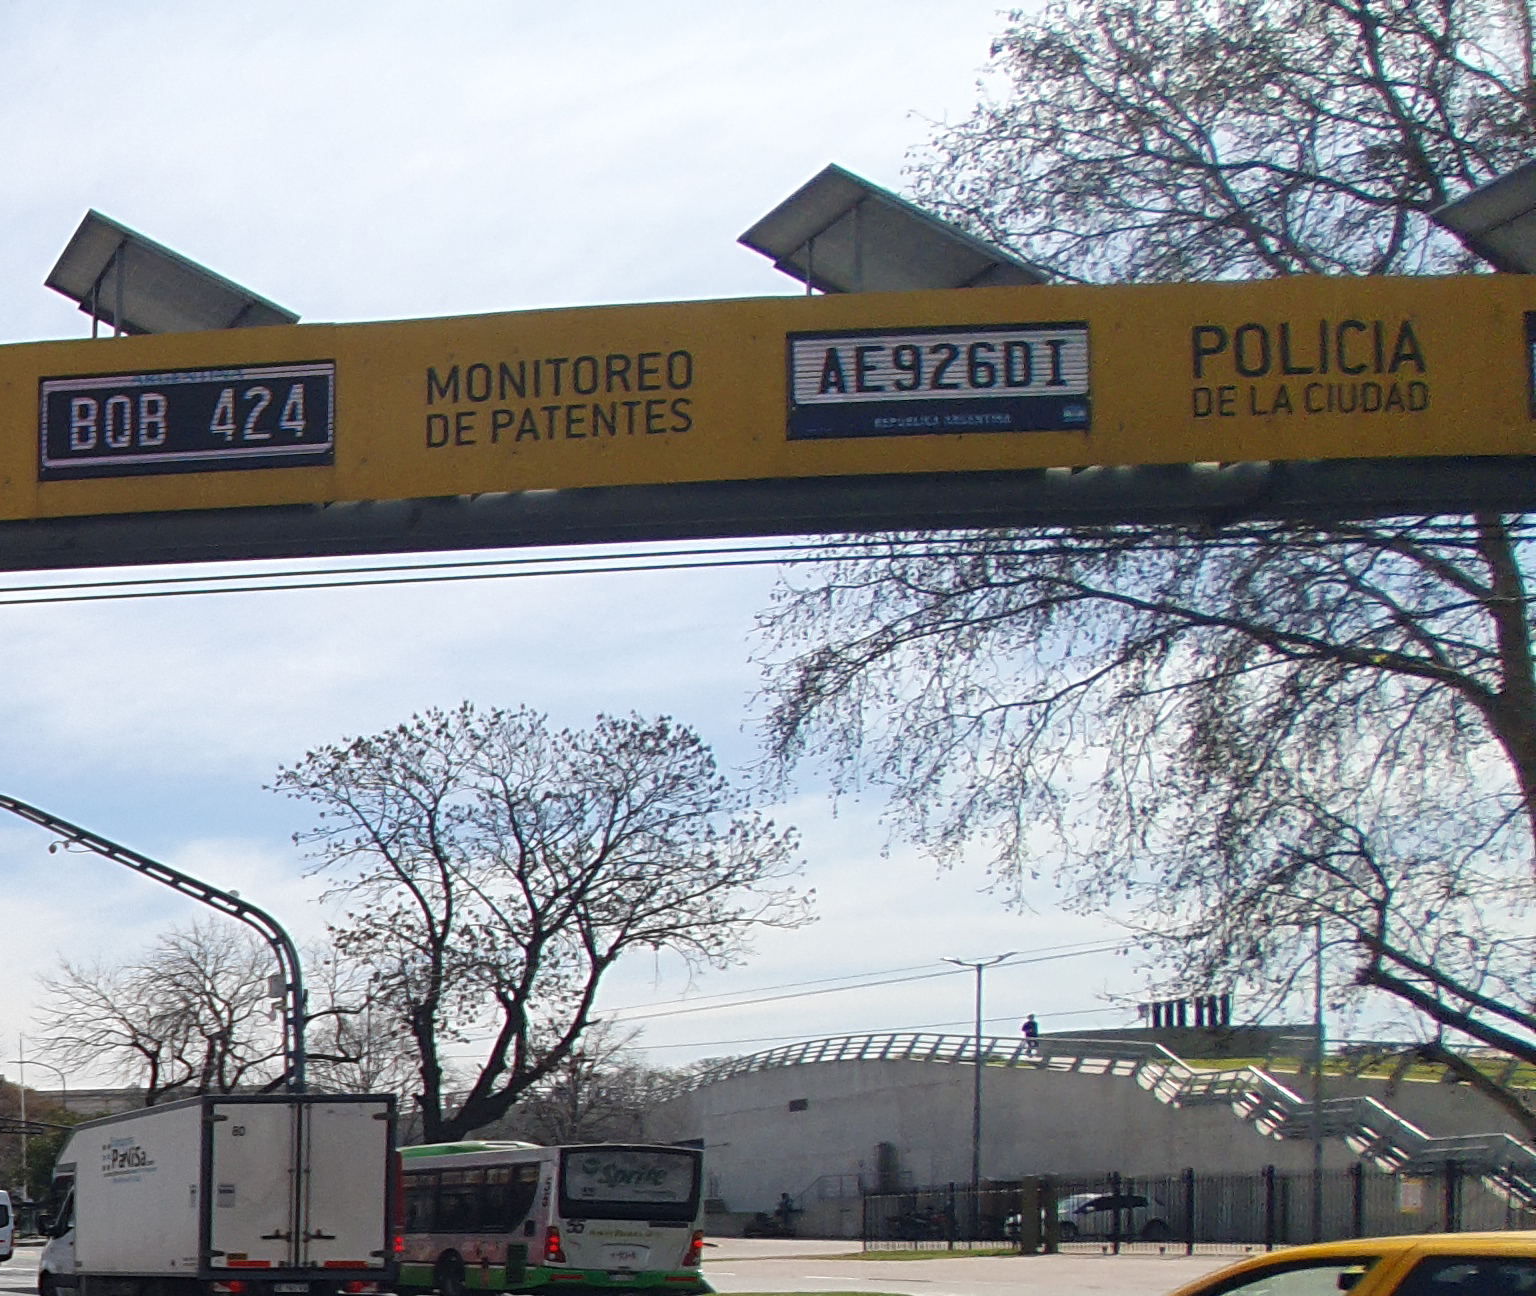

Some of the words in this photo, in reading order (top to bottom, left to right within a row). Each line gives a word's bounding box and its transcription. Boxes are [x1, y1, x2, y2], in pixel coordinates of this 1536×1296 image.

[818, 339, 1066, 395] AE926DI
[1191, 319, 1426, 378] POLICIA
[426, 350, 693, 406] MONITOREO
[1193, 385, 1237, 418] DE
[1250, 384, 1295, 416] LA
[1305, 381, 1430, 414] CIUDAD
[210, 383, 306, 441] 424
[426, 411, 477, 448] DE
[491, 398, 693, 444] PATENTES
